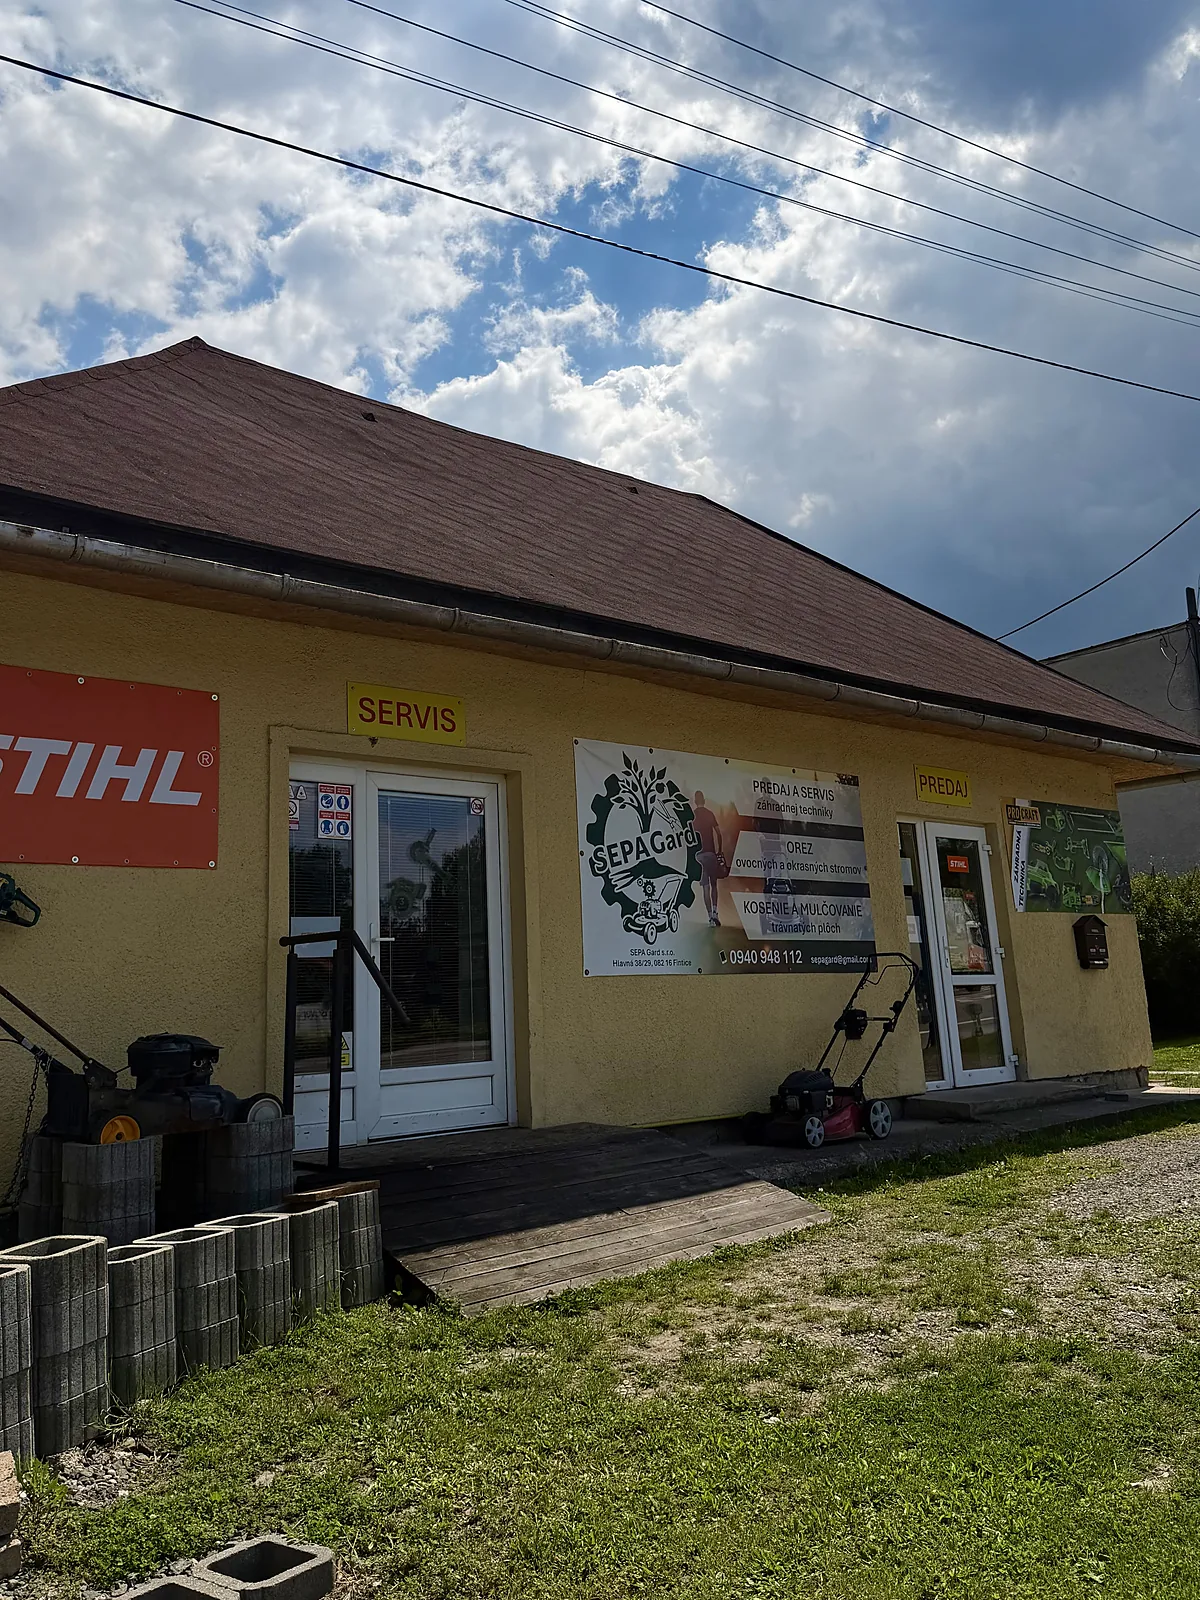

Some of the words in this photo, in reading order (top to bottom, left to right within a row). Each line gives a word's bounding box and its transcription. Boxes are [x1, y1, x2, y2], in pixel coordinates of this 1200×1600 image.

[357, 696, 457, 734] SERVIS
[0, 733, 203, 807] TIHL
[753, 780, 790, 796] PREDAJ
[792, 784, 800, 797] A
[801, 785, 835, 802] SERVIS
[918, 773, 968, 798] PREDAJ
[757, 801, 798, 816] záhradnej
[800, 804, 834, 819] techniky
[1007, 806, 1020, 820] PRO
[1021, 808, 1039, 822] CRAFT
[592, 836, 650, 873] SEPA
[650, 821, 696, 854] Gard
[786, 841, 814, 854] OREZ
[1014, 829, 1022, 883] ZÁHRADNÁ
[736, 858, 778, 871] ovocných
[787, 861, 830, 875] okrasných
[831, 865, 862, 875] stromov
[744, 901, 789, 915] KOSENIE
[791, 902, 799, 915] A
[801, 901, 862, 917] MULČOVANIE
[771, 922, 816, 935] trávnatých
[818, 921, 841, 935] plôch
[630, 948, 646, 956] SEPA
[647, 948, 661, 956] Gard
[662, 948, 676, 956] s.r.o.
[729, 949, 758, 964] 0940
[760, 949, 781, 964] 948
[783, 950, 803, 963] 112
[635, 959, 654, 968] 38/29,
[654, 959, 665, 967] 082
[666, 959, 673, 967] 16
[673, 959, 692, 967] Fintice
